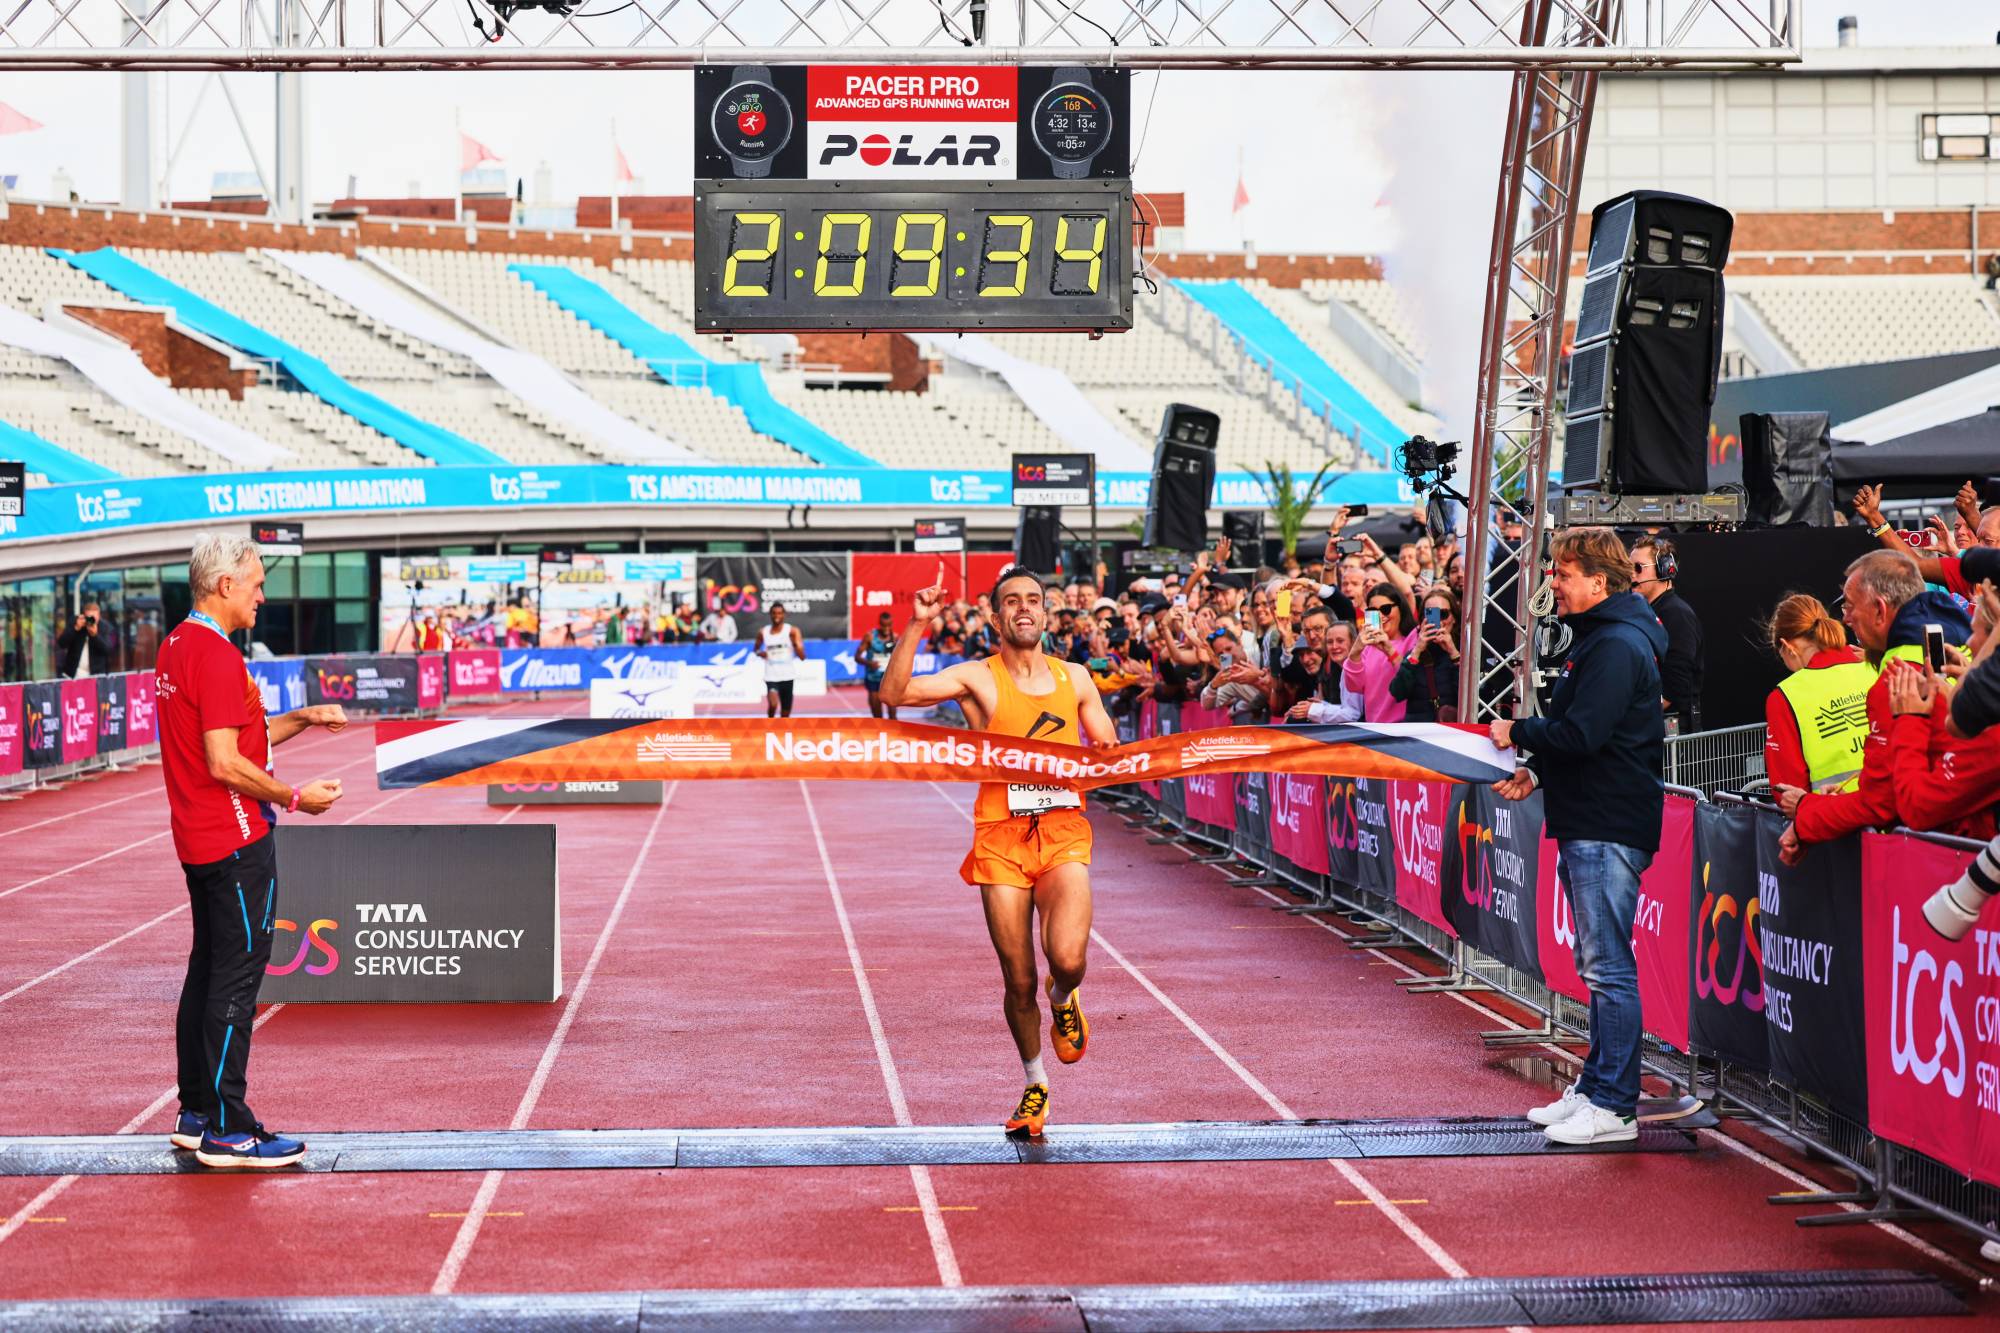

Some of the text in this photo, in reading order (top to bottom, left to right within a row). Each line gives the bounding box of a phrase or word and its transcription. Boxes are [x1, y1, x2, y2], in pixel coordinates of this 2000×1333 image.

[846, 76, 979, 96] PACER PRO
[815, 97, 1010, 109] ADVANCED GPS RUNNING WATCH
[1063, 101, 1081, 111] 168
[1047, 118, 1069, 128] 4:32
[819, 133, 1001, 166] POLAR
[722, 213, 1107, 297] 2:09:34
[205, 478, 427, 513] TCS AMSTERDAM MARATHON
[490, 473, 521, 500] tcs
[627, 474, 862, 501] TCS AMSTERDAM MARATHON
[930, 475, 961, 501] tcs
[75, 492, 104, 523] tcs
[761, 578, 795, 590] TATA
[761, 589, 836, 602] CONSULTANCY
[765, 732, 1151, 779] Nederlands kampioen
[564, 781, 620, 792] SERVICES
[1009, 783, 1068, 792] CHOUKO
[1037, 797, 1052, 807] 23
[355, 903, 427, 923] TATA
[265, 918, 339, 976] cs
[354, 929, 525, 949] CONSULTANCY
[1696, 861, 1766, 1012] tcs
[354, 955, 462, 976] SERVICES
[1760, 925, 1833, 985] ONSULTANCY
[1890, 904, 1966, 1098] tcs
